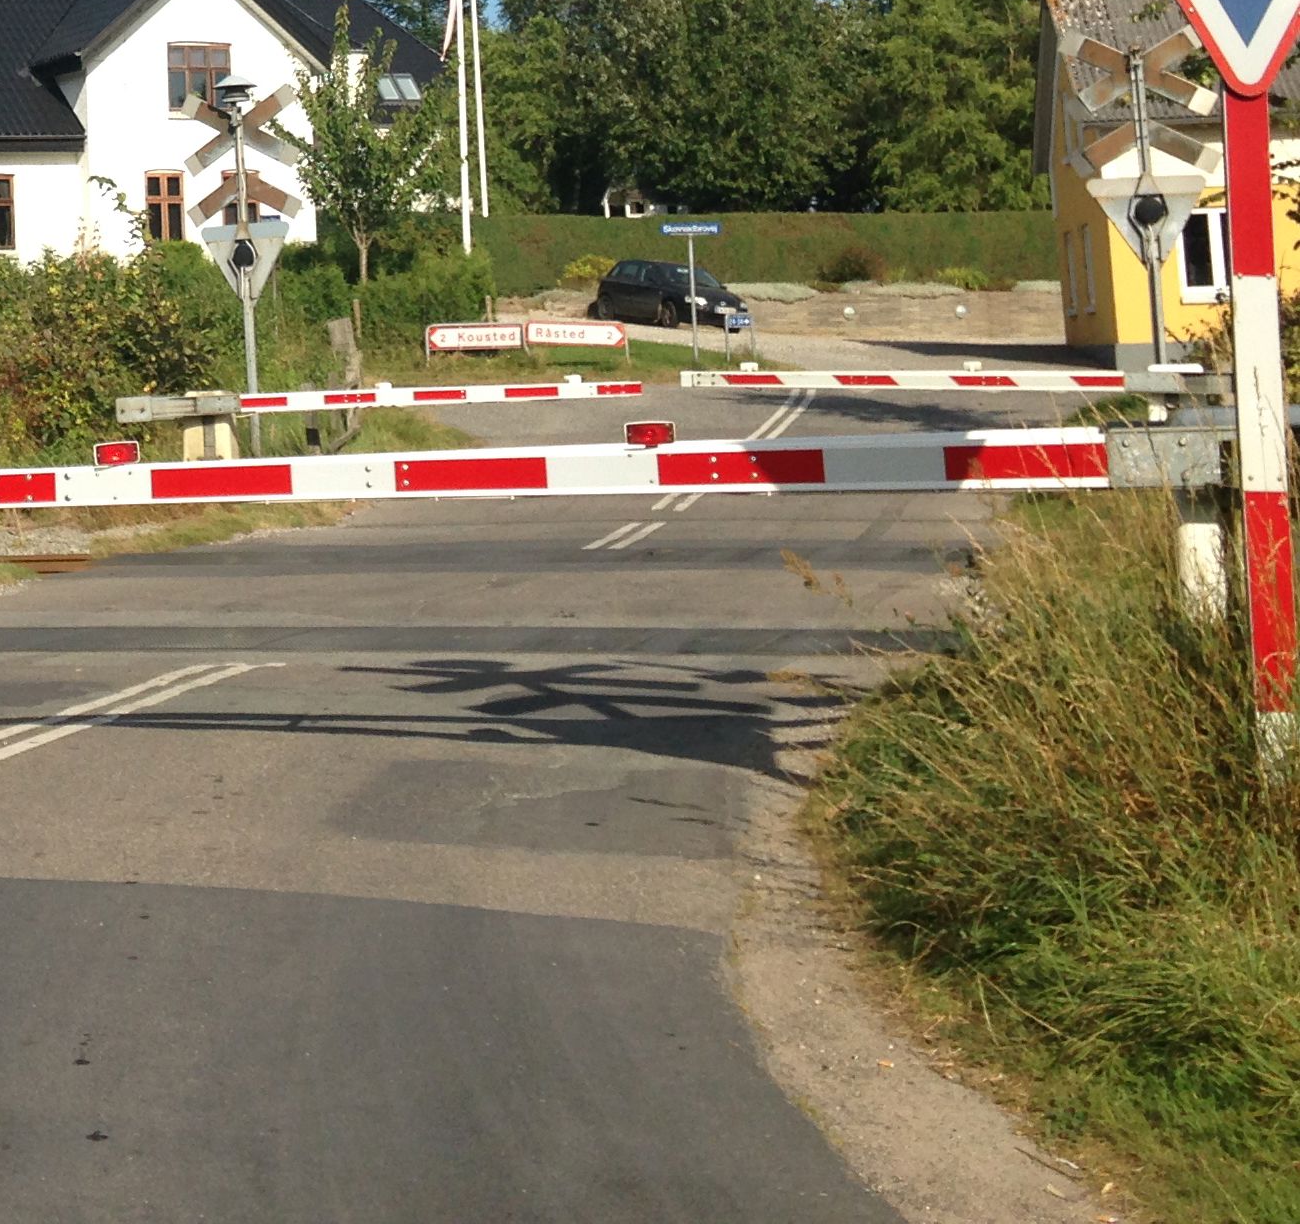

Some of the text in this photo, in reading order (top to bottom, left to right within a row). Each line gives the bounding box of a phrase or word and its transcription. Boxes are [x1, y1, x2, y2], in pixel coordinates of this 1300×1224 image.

[440, 331, 516, 343] 2 Kousted
[535, 327, 613, 340] Råsted 2
